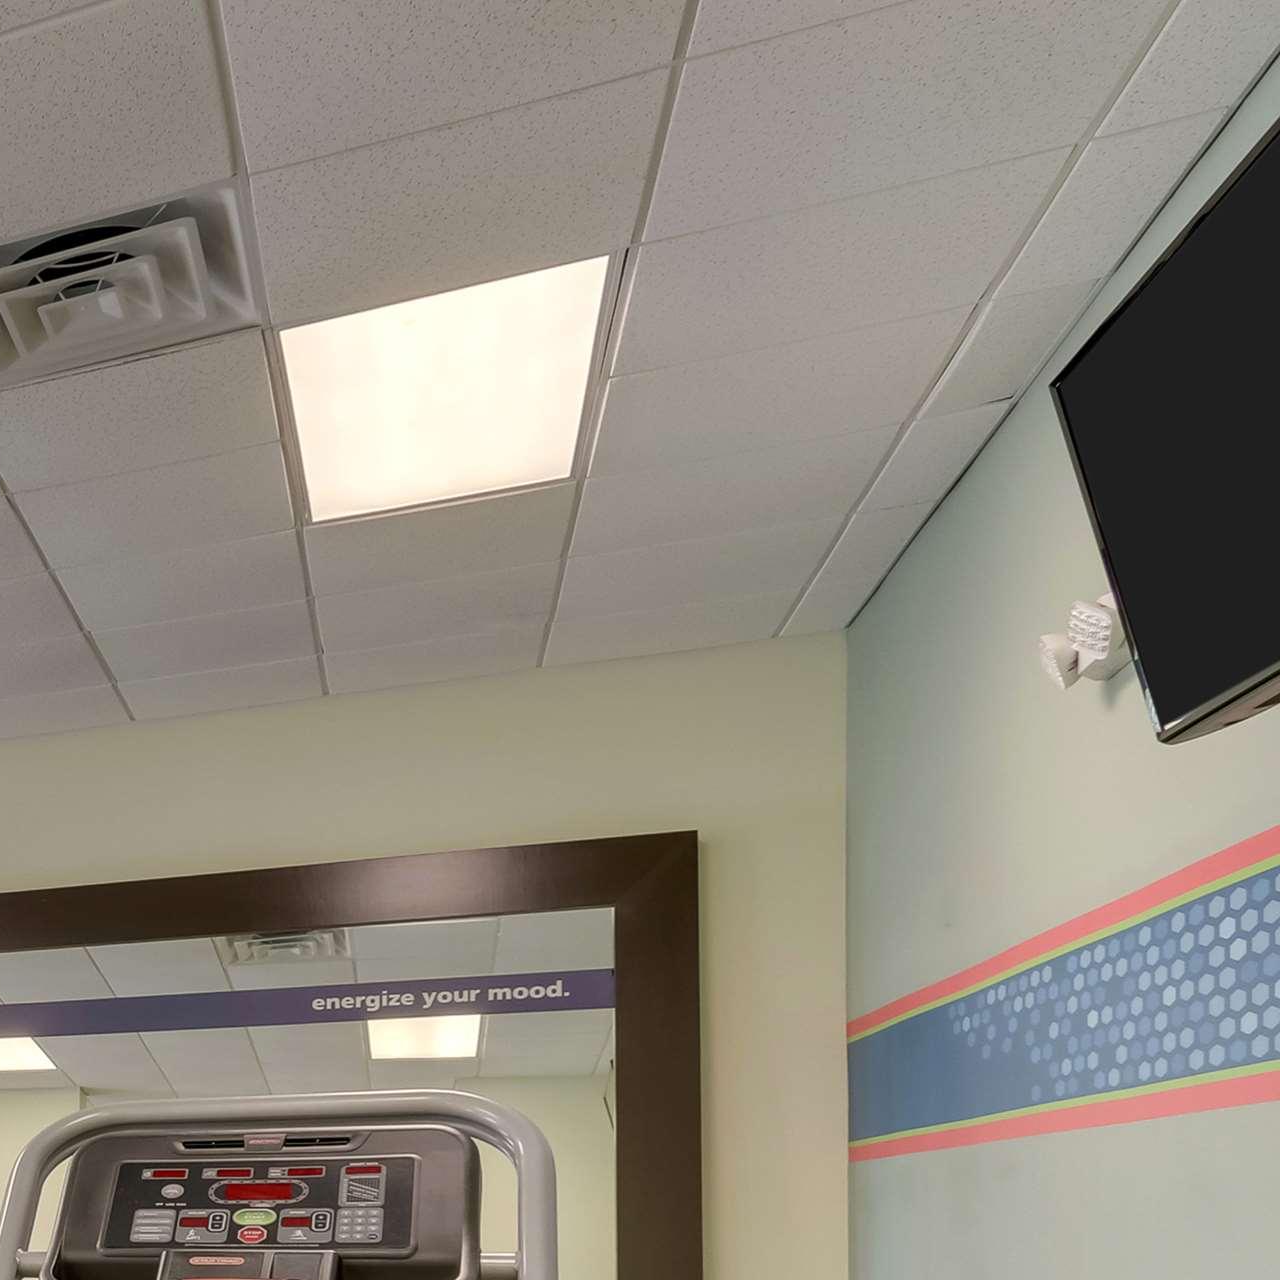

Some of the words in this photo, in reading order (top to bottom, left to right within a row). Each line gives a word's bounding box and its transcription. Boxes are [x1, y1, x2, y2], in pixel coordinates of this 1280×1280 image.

[311, 991, 415, 1012] energize
[422, 988, 481, 1009] your
[487, 980, 570, 1001] mood.
